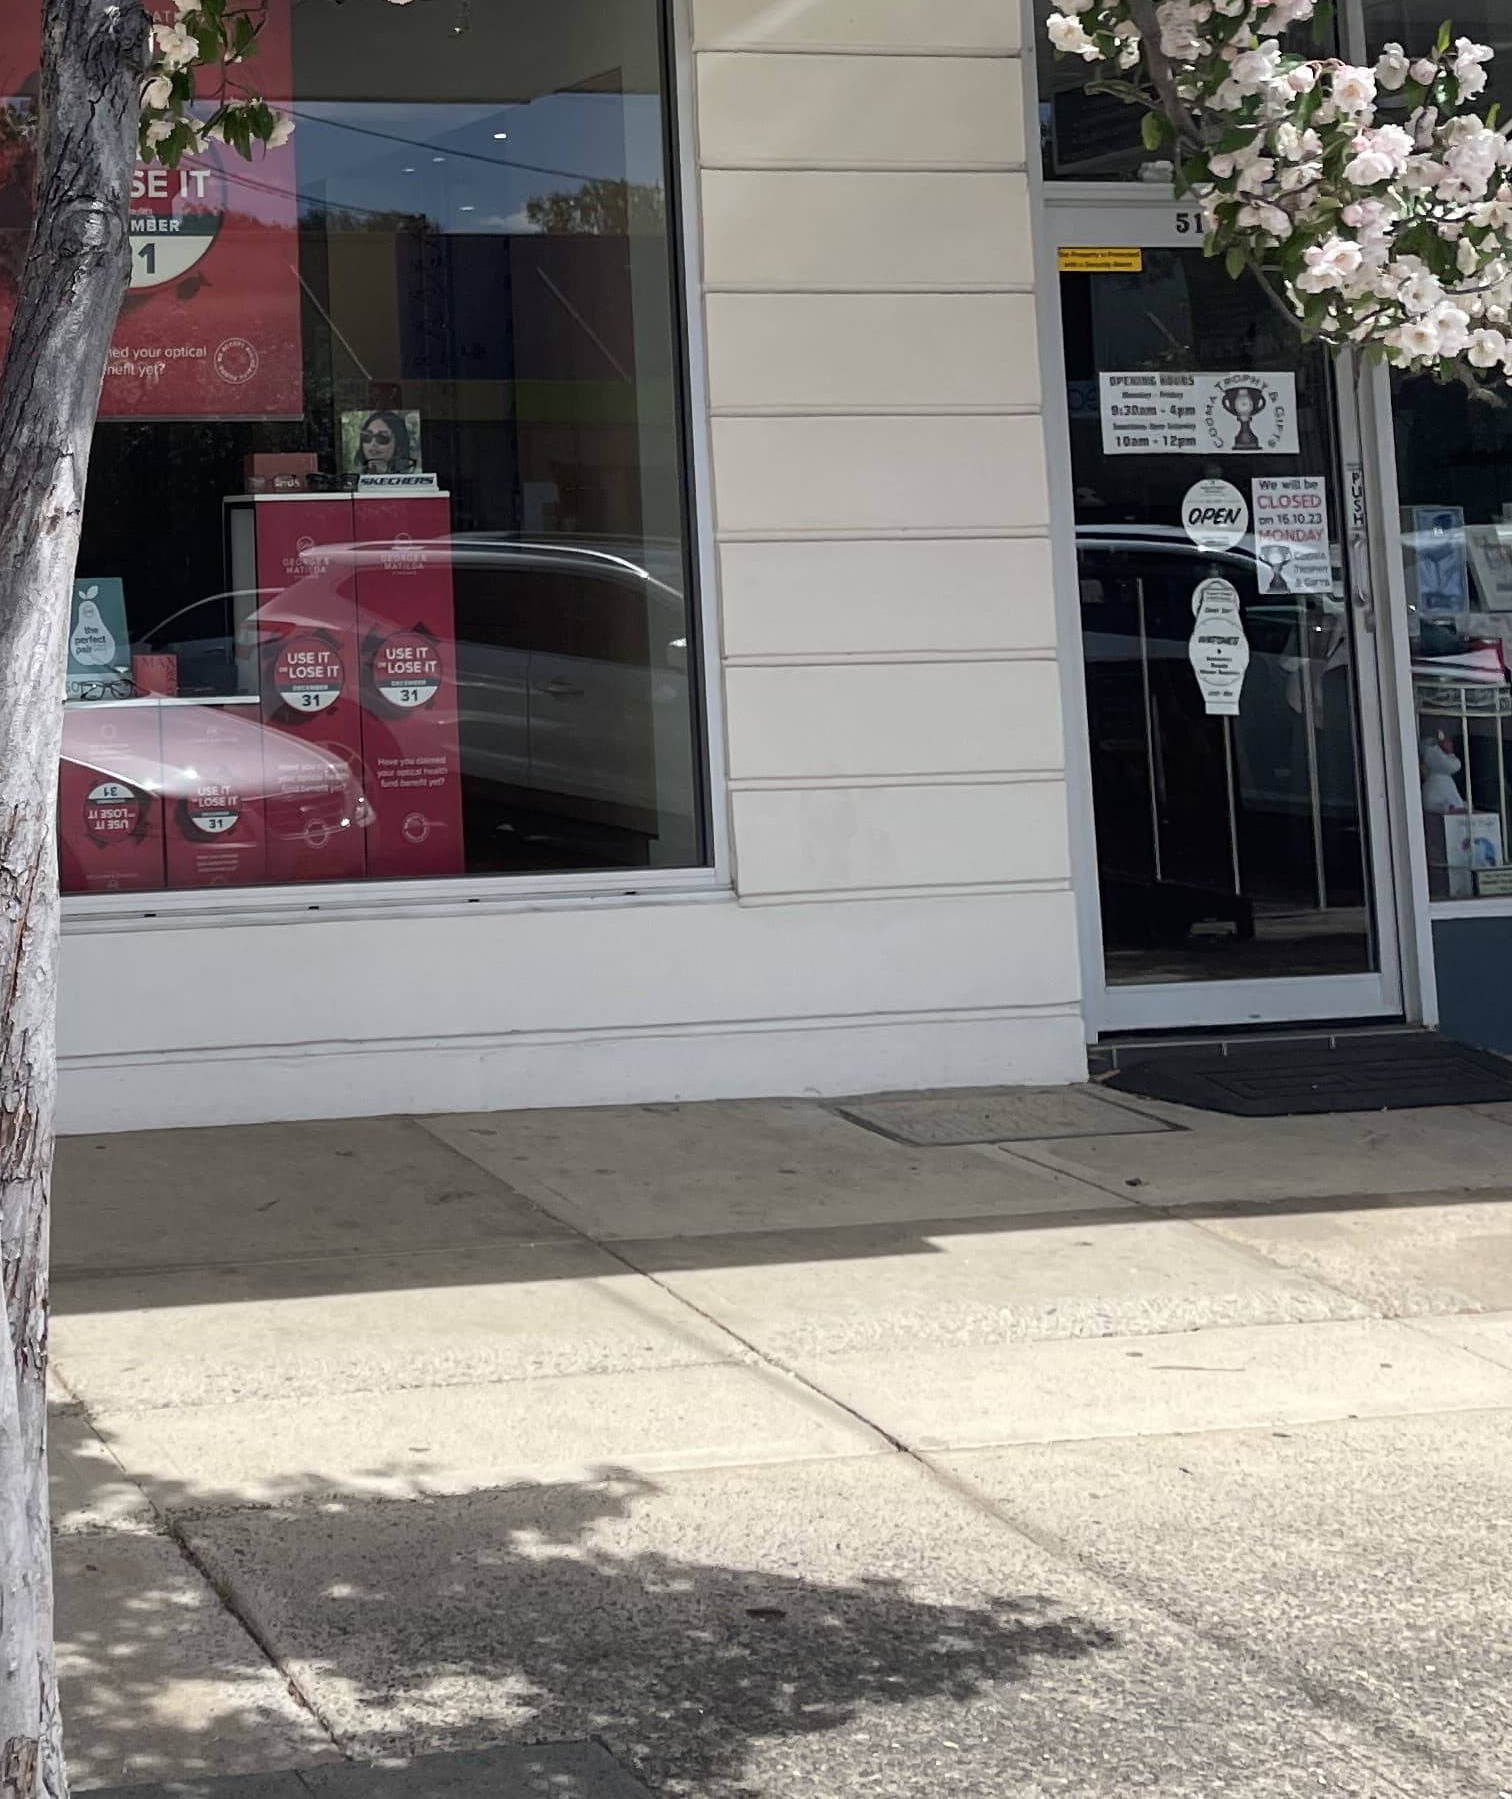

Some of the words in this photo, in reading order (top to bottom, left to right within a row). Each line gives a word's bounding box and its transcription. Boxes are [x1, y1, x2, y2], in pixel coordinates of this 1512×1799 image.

[130, 169, 168, 199] SE
[180, 169, 210, 199] IT
[130, 219, 180, 232] MBER
[1175, 212, 1204, 234] 51
[138, 243, 156, 274] 1
[132, 348, 160, 361] your
[164, 345, 207, 359] optical
[138, 362, 165, 378] yet?
[1109, 376, 1157, 387] OPENING
[1159, 375, 1195, 386] HOURS
[1214, 374, 1269, 393] TROPHY
[1111, 405, 1157, 416] 9:30am
[1170, 404, 1196, 418] 4pm
[1115, 436, 1150, 447] 10am
[1162, 435, 1197, 448] 12pm
[360, 476, 434, 486] SKECHERS
[1259, 480, 1277, 490] We
[1281, 480, 1301, 490] will
[1304, 479, 1319, 490] be
[1257, 494, 1322, 509] CLOSED
[1351, 472, 1365, 525] PUSH
[1189, 507, 1242, 525] OPEN
[1258, 528, 1324, 542] MONDAY
[288, 652, 315, 664] USE
[318, 651, 331, 663] IT
[386, 648, 412, 660] USE
[415, 647, 428, 659] IT
[289, 666, 324, 679] LOSE
[327, 665, 340, 678] IT
[387, 661, 422, 674] LOSE
[425, 661, 437, 674] IT
[302, 694, 321, 707] 31
[400, 689, 419, 702] 31
[197, 786, 218, 796] USE
[199, 797, 225, 807] LOSE
[228, 796, 238, 806] IT
[209, 819, 223, 829] 31
